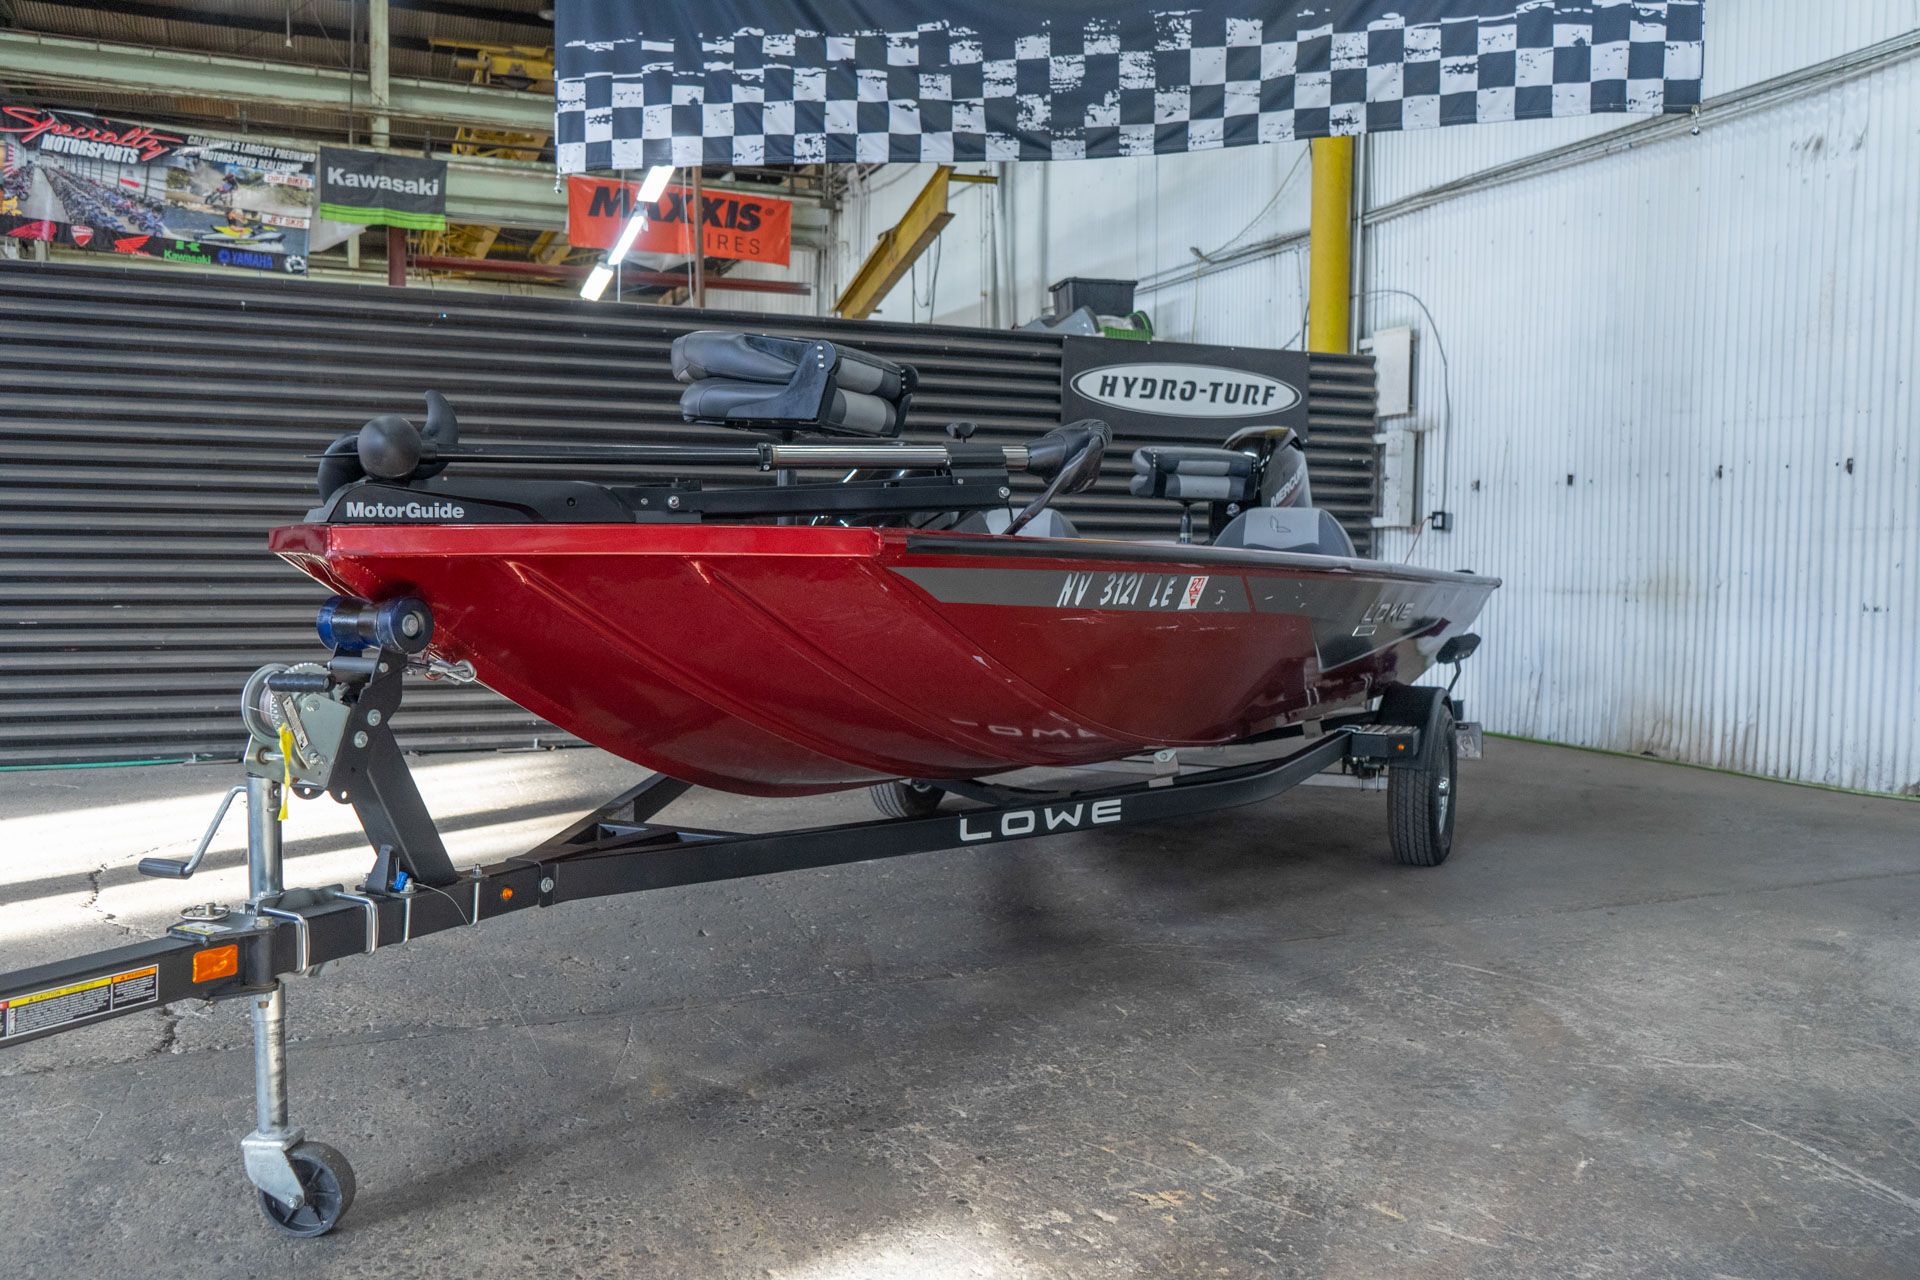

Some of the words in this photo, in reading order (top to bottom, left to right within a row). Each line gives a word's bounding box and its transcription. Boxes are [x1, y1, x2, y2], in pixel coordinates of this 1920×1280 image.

[0, 106, 183, 161] Specialty
[41, 133, 140, 164] MOTORSPORTS
[200, 150, 258, 167] MOTORSPORTS
[240, 141, 275, 157] LARGEST
[327, 166, 440, 196] Kawasaki
[693, 230, 761, 256] IRES
[163, 249, 212, 265] Kawasaki
[231, 252, 273, 269] YAMAHA
[1099, 374, 1277, 406] HYDRO-TURF
[346, 502, 465, 519] MotorGuide
[1056, 572, 1094, 608] NV
[1100, 572, 1145, 606] 3121
[1149, 575, 1178, 608] LE
[1189, 578, 1206, 592] 24
[1361, 602, 1416, 623] LOWE
[959, 798, 1122, 842] LOWE
[34, 990, 61, 1002] CAUTION
